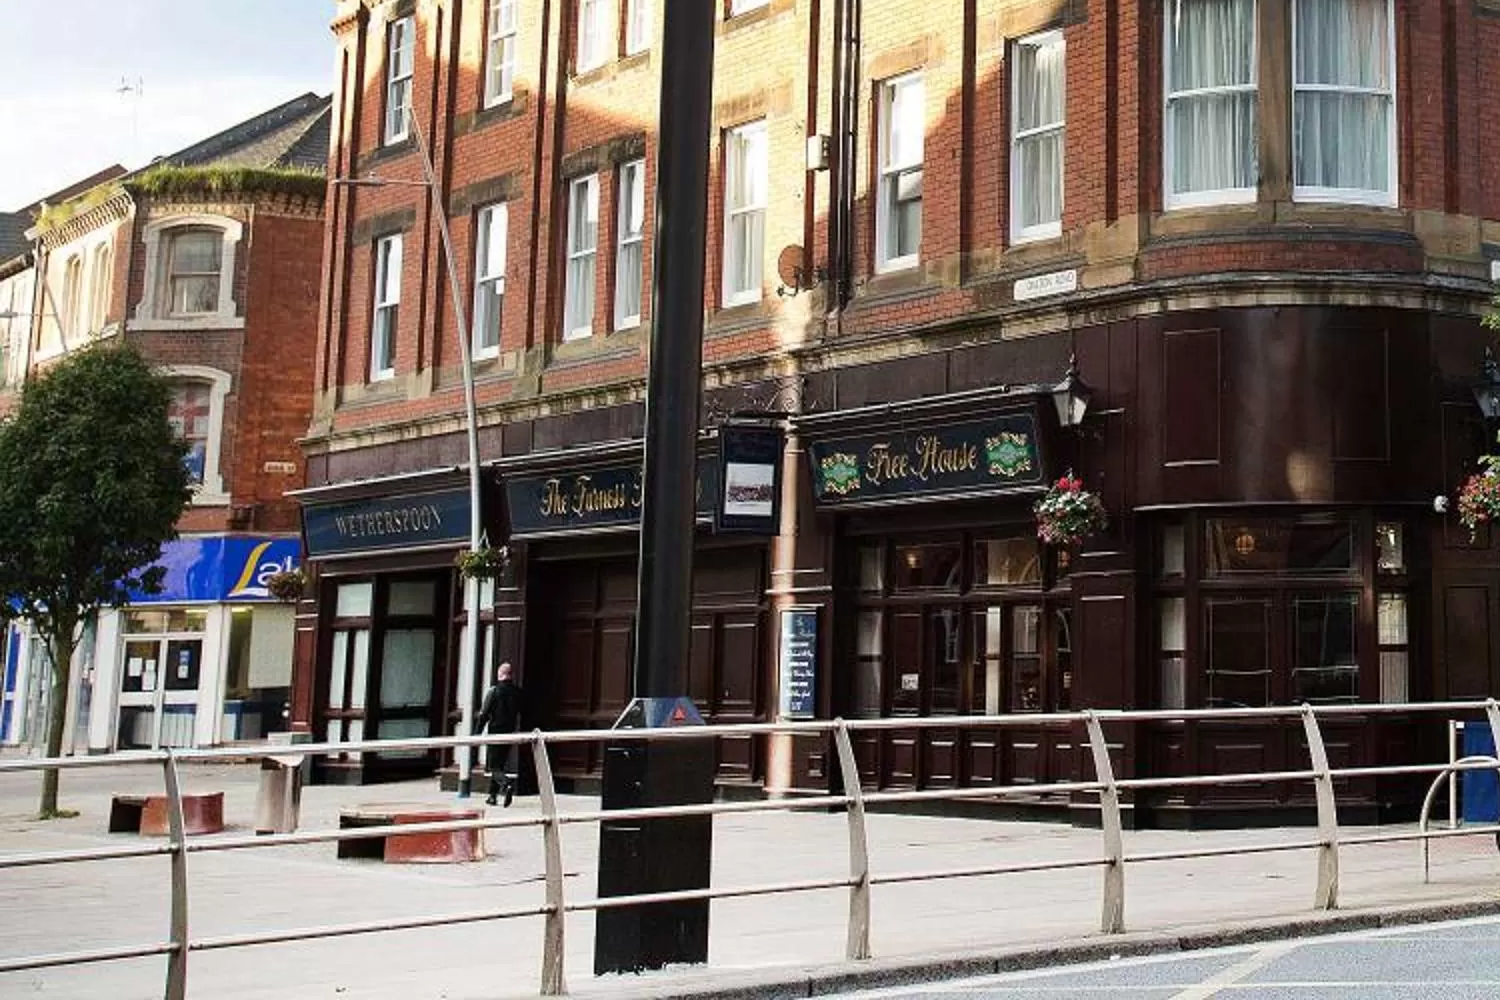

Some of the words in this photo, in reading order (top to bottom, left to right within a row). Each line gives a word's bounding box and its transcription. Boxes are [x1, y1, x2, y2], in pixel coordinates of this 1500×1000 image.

[865, 444, 909, 485] Free
[911, 434, 977, 481] House
[540, 477, 567, 516] The
[571, 474, 626, 517] Furness
[335, 503, 444, 538] WETHERSPOON
